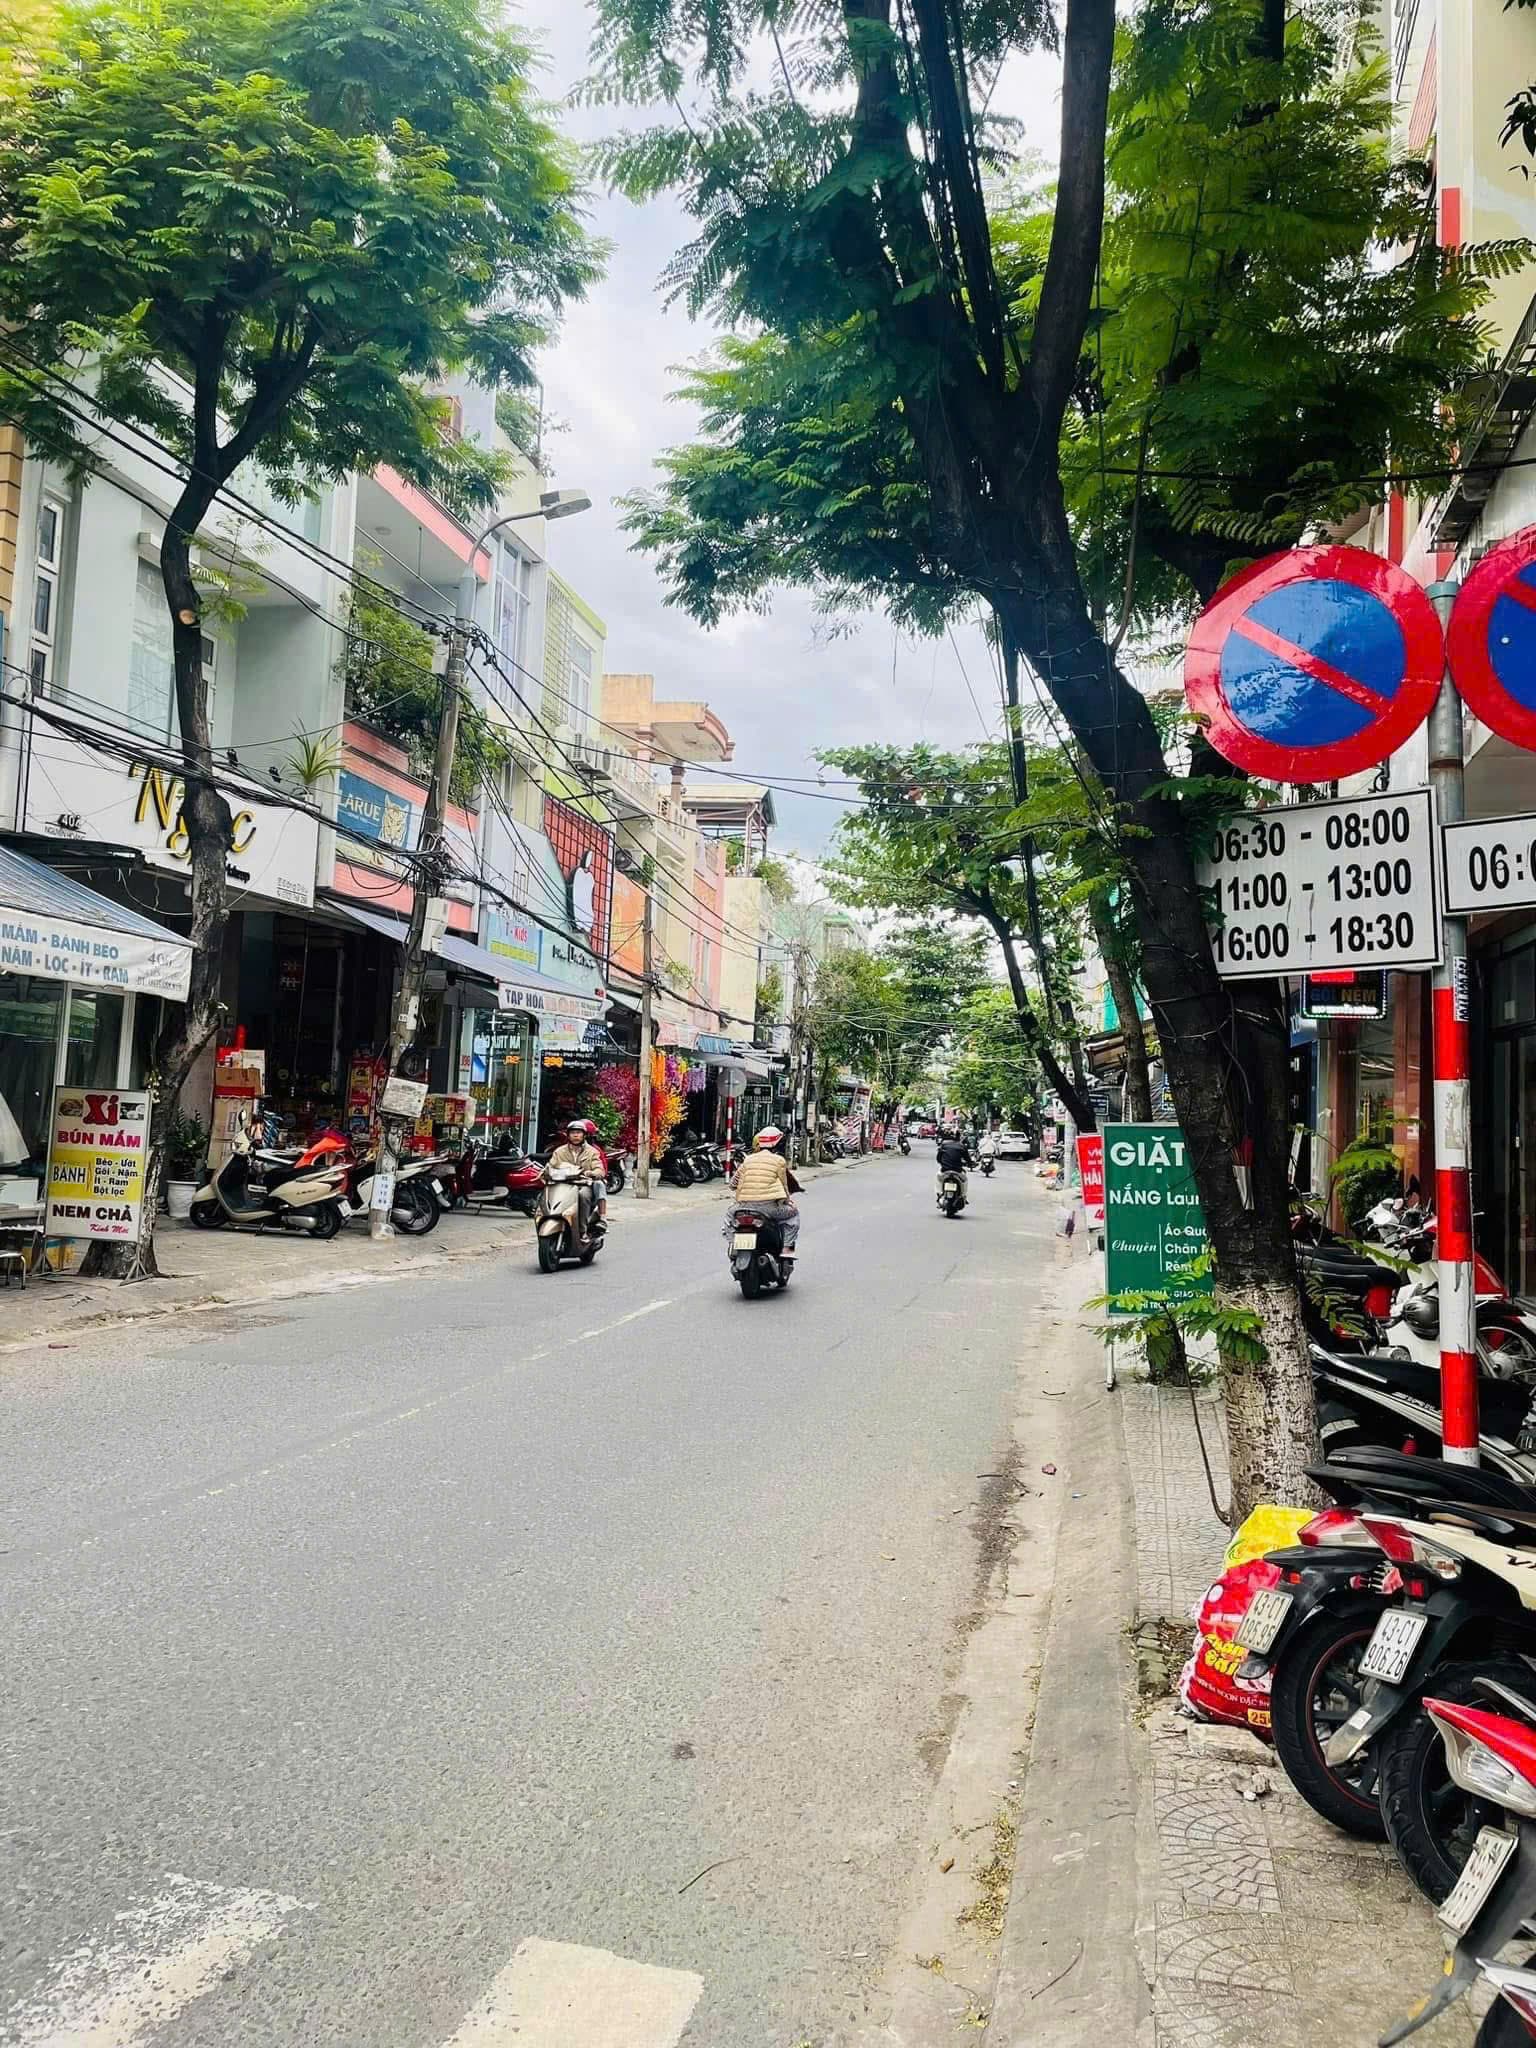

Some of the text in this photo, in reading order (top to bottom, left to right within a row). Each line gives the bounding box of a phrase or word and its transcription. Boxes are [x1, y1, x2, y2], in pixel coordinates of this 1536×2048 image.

[1209, 822, 1285, 864] 06:30
[1325, 807, 1410, 850] 08:00
[1212, 872, 1287, 913] 11:00
[1328, 858, 1411, 901] 13:00
[1211, 923, 1289, 963] 16:00
[1330, 912, 1414, 953] 18:30
[103, 965, 129, 984] RAM
[57, 1129, 94, 1145] BÚN
[1110, 1136, 1185, 1174] GIẶT
[1109, 1183, 1162, 1205] NẮNG
[52, 1204, 91, 1219] NEM
[1253, 1593, 1287, 1621] 43-C1
[1382, 1616, 1417, 1646] 43-C1
[1364, 1643, 1408, 1677] 906.26
